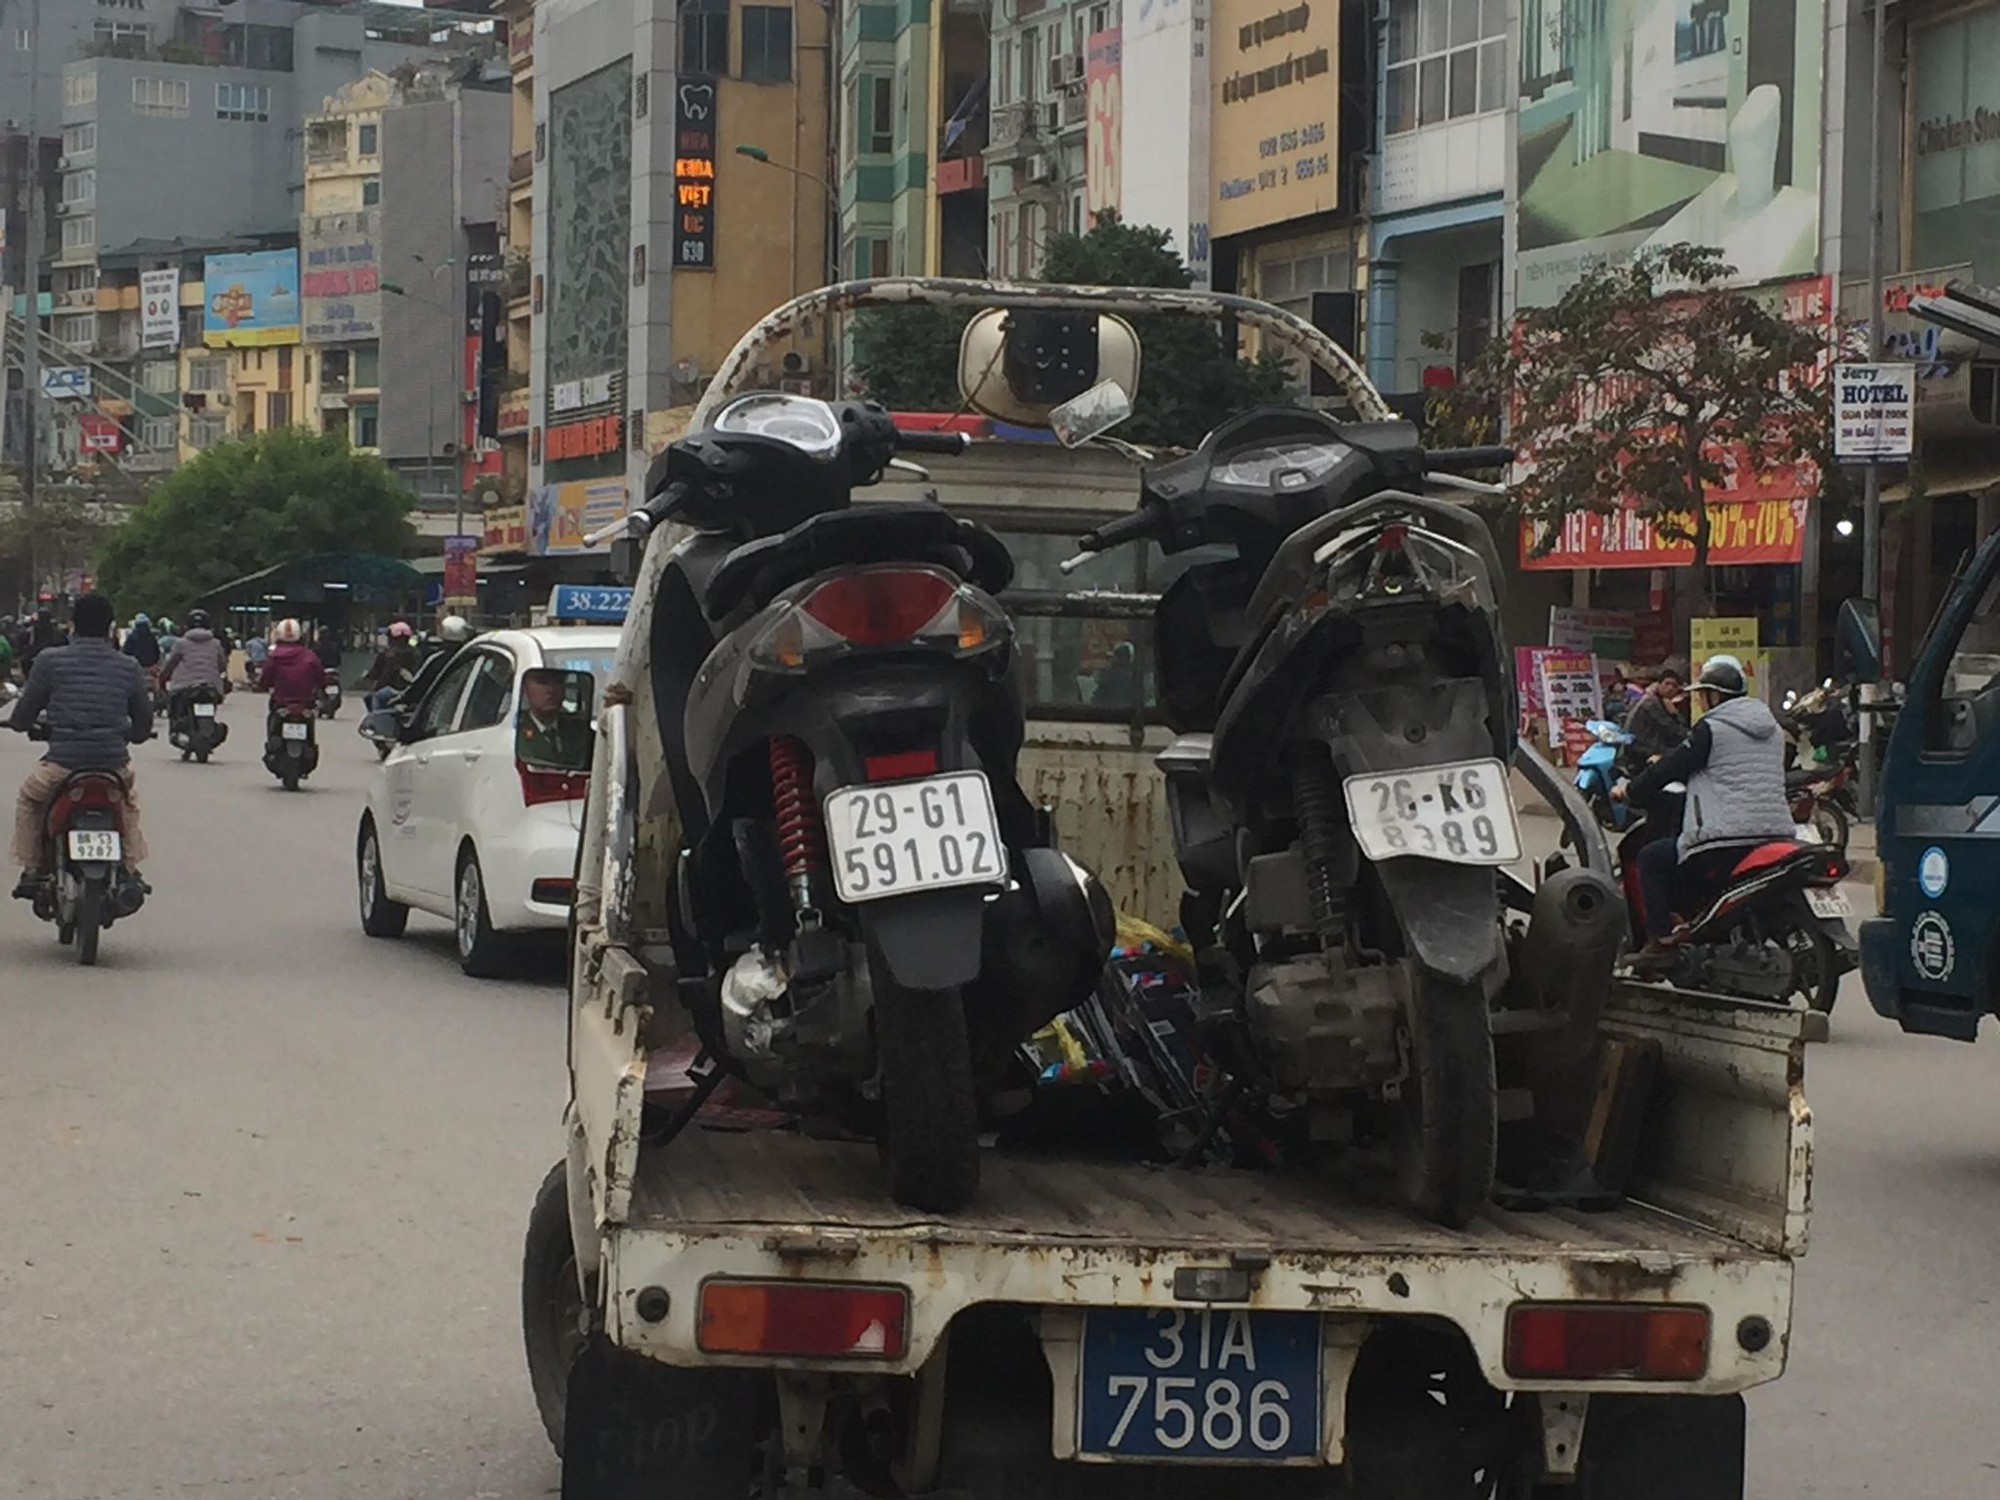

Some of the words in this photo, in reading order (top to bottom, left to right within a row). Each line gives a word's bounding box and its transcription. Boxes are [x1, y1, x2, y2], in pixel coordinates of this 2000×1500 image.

[1918, 113, 1971, 155] Chicken
[676, 158, 713, 178] KHOA
[682, 240, 704, 262] 630
[1842, 367, 1879, 382] Jerry
[1842, 384, 1908, 404] HOTEL
[850, 782, 965, 838] 29-G1
[1370, 769, 1486, 823] 26-K6
[1382, 815, 1498, 856] 8389
[844, 831, 993, 892] 591.02
[1144, 1309, 1256, 1371] 31A
[1108, 1375, 1291, 1451] 7586
